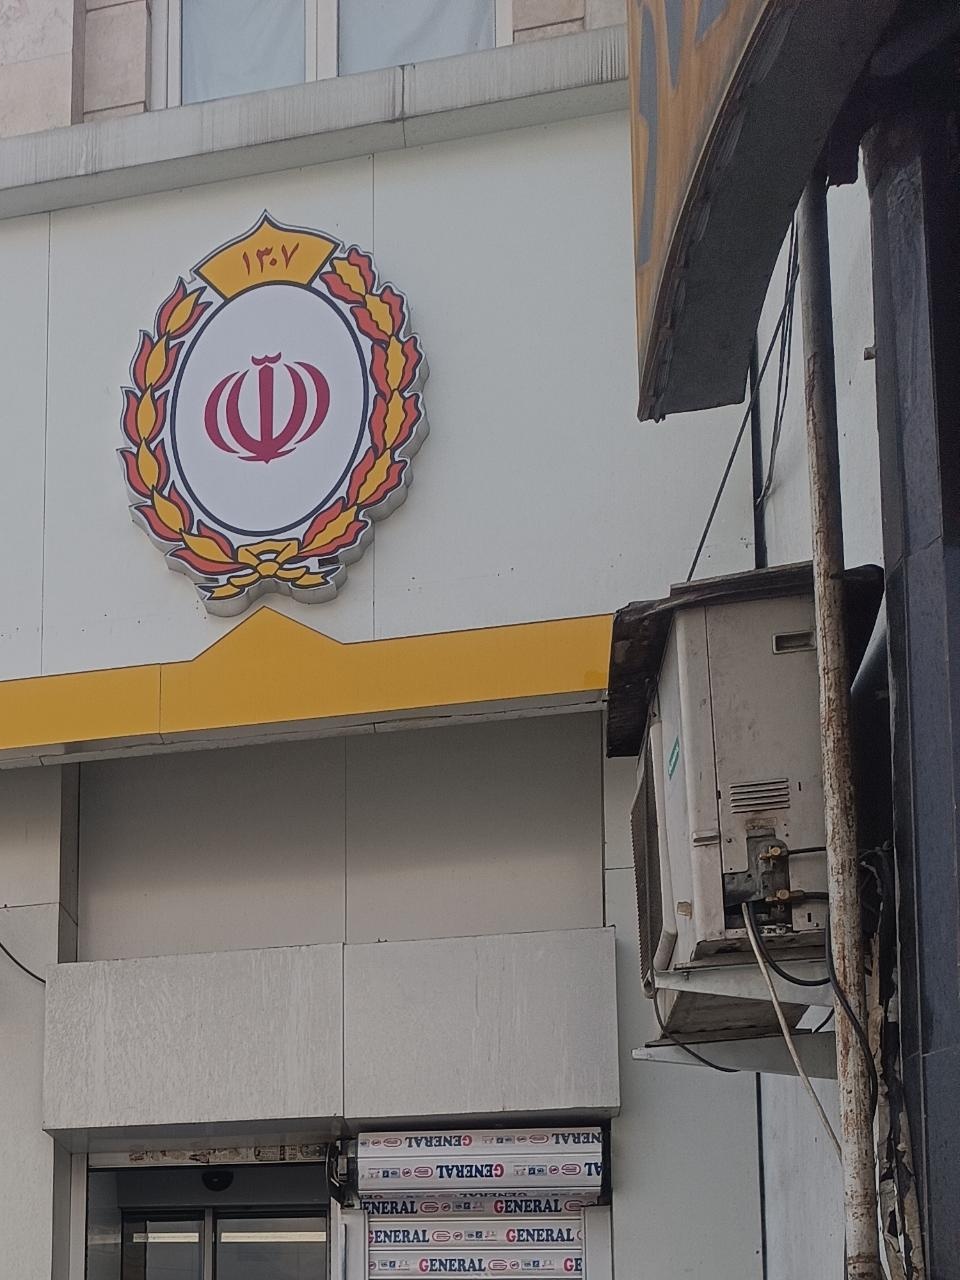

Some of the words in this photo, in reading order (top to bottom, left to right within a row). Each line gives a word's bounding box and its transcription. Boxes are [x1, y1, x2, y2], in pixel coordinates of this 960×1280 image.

[241, 242, 301, 277] ۱۳۰۷
[405, 1135, 473, 1149] GENERAL
[436, 1163, 505, 1179] GENERAL
[493, 1199, 562, 1214] GENERAL
[505, 1228, 574, 1243] GENERAL
[419, 1257, 486, 1272] GENERAL
